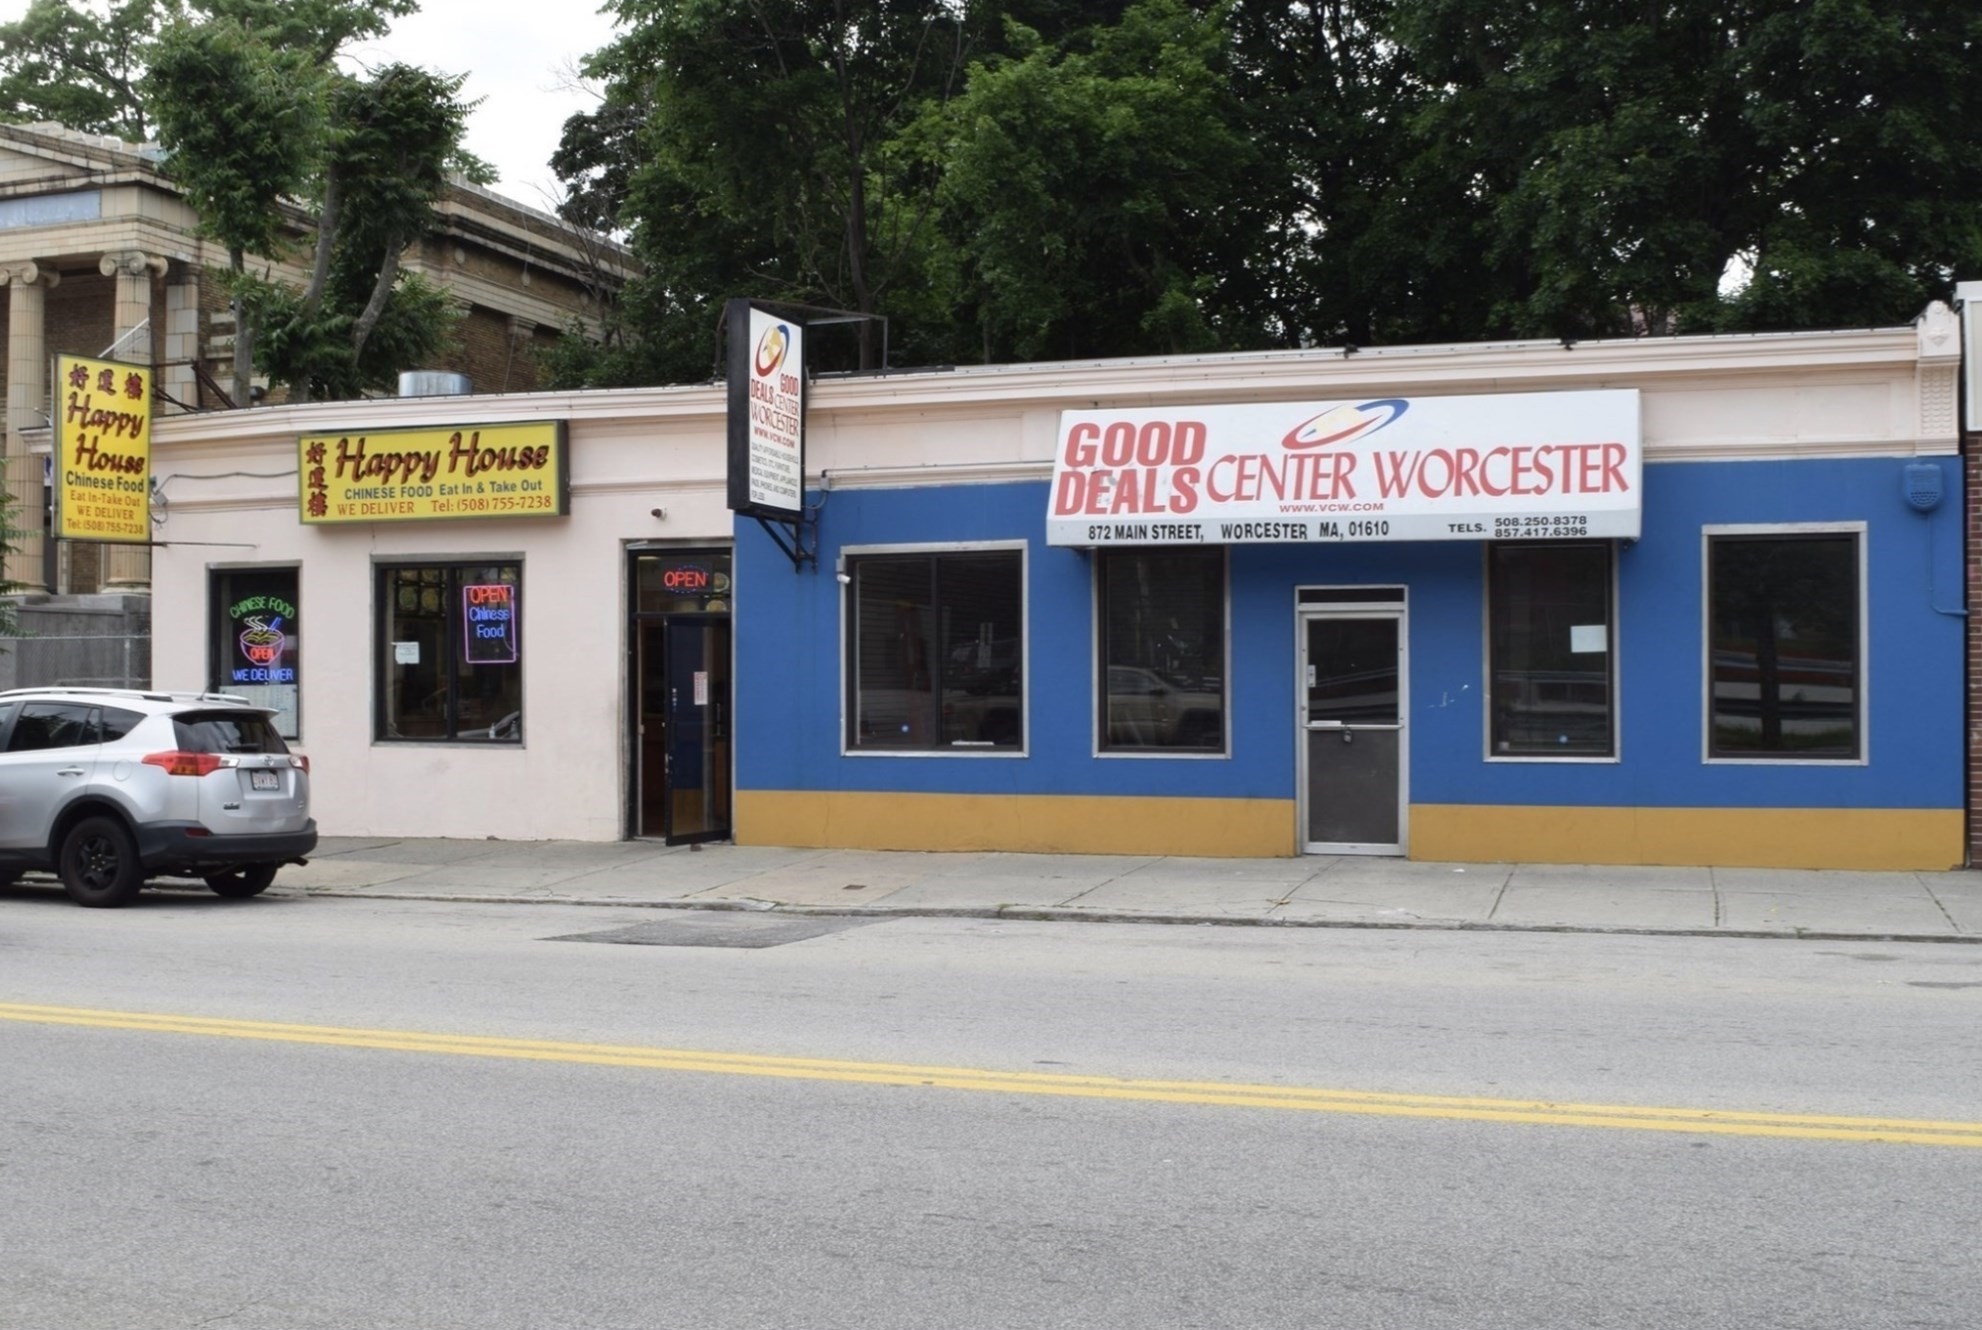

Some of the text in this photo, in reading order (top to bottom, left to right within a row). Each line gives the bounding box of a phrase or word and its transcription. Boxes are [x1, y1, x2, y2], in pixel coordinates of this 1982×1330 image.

[780, 373, 799, 397] GOOD
[751, 378, 800, 418] DEALS CENTER
[67, 391, 145, 439] Happy
[750, 400, 800, 437] WORCESTER
[75, 433, 146, 475] House
[1064, 421, 1207, 468] GOOD
[335, 431, 550, 485] Happy House
[66, 470, 144, 493] Chinese Food
[1206, 442, 1629, 502] CENTER WORCESTER
[70, 489, 141, 507] Eat In-Take Out
[345, 479, 543, 500] CHINESE FOOD Eat In & Take Out
[1054, 467, 1201, 516] DEALS
[77, 504, 134, 520] WE DELIVER
[337, 495, 552, 516] WE DELIVER Tel: (508) 755-7238
[1279, 502, 1385, 513] WWW.VCW.COM
[67, 518, 144, 535] Tel: (508) 755-7238
[1088, 520, 1389, 543] 872 MAIN STREET, WORCESTER MA, 01610
[1448, 515, 1587, 533] TELS. 508.250.8378
[1494, 526, 1587, 537] 857.417.6396
[664, 571, 707, 587] OPEN
[469, 587, 508, 604] OPEN
[229, 596, 295, 620] CHINESE FOOD
[469, 606, 510, 621] Chinese
[476, 624, 505, 638] Food
[250, 647, 275, 660] OPEN
[232, 668, 294, 681] WE DELIVER
